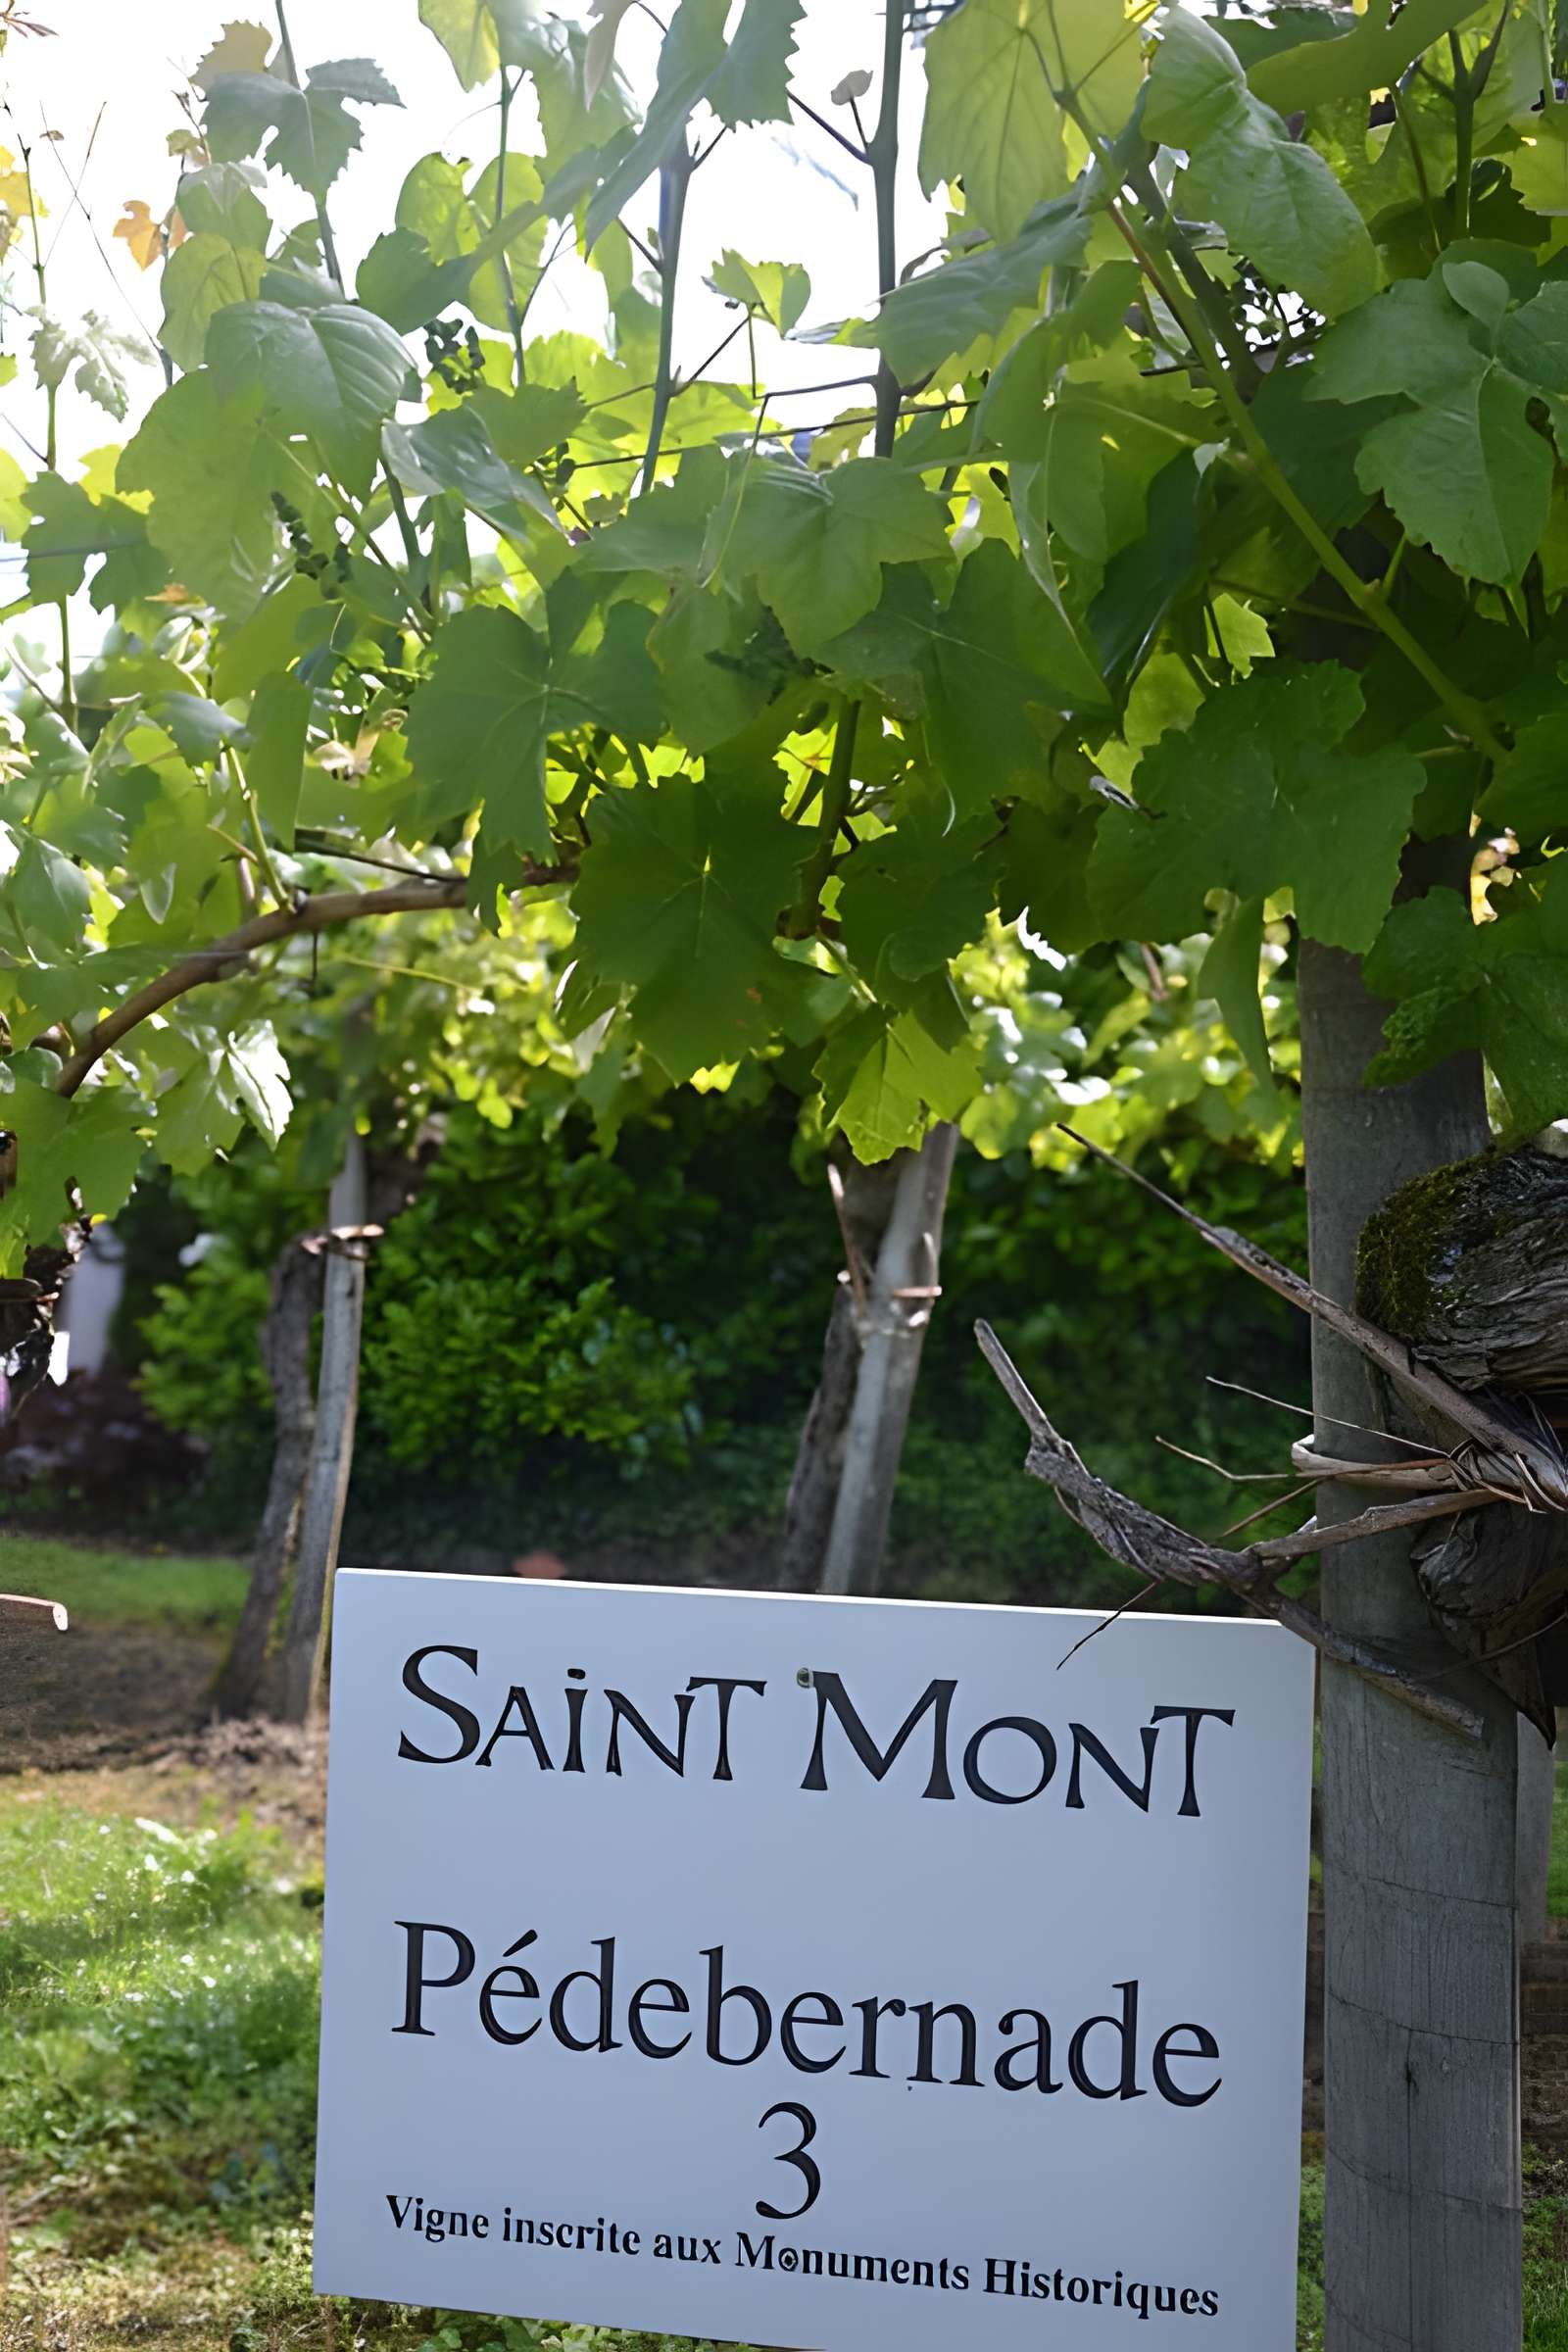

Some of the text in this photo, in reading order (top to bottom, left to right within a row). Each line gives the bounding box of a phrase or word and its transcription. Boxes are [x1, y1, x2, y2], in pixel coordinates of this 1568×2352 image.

[798, 1669, 1237, 1818] MONT
[391, 1920, 1223, 2108] Pédebernade
[755, 2101, 822, 2221] 3
[385, 2194, 1220, 2321] Vigne inscrite aux Monuments Historiques
